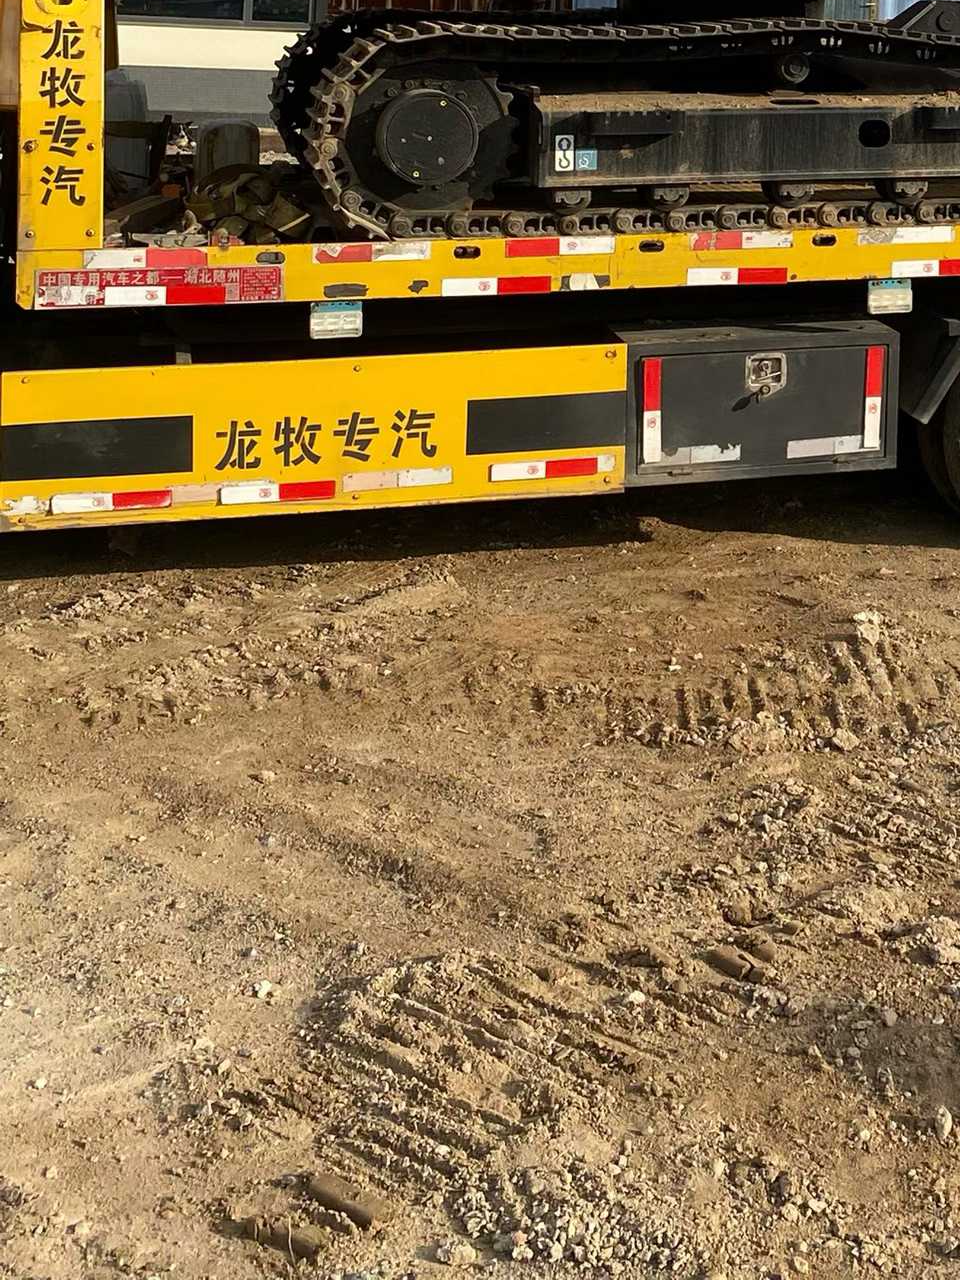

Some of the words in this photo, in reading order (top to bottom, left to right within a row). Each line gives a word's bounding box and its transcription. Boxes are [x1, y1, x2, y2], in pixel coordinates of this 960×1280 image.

[38, 19, 87, 207] 龙牧专汽
[214, 408, 438, 471] 龙牧专汽
